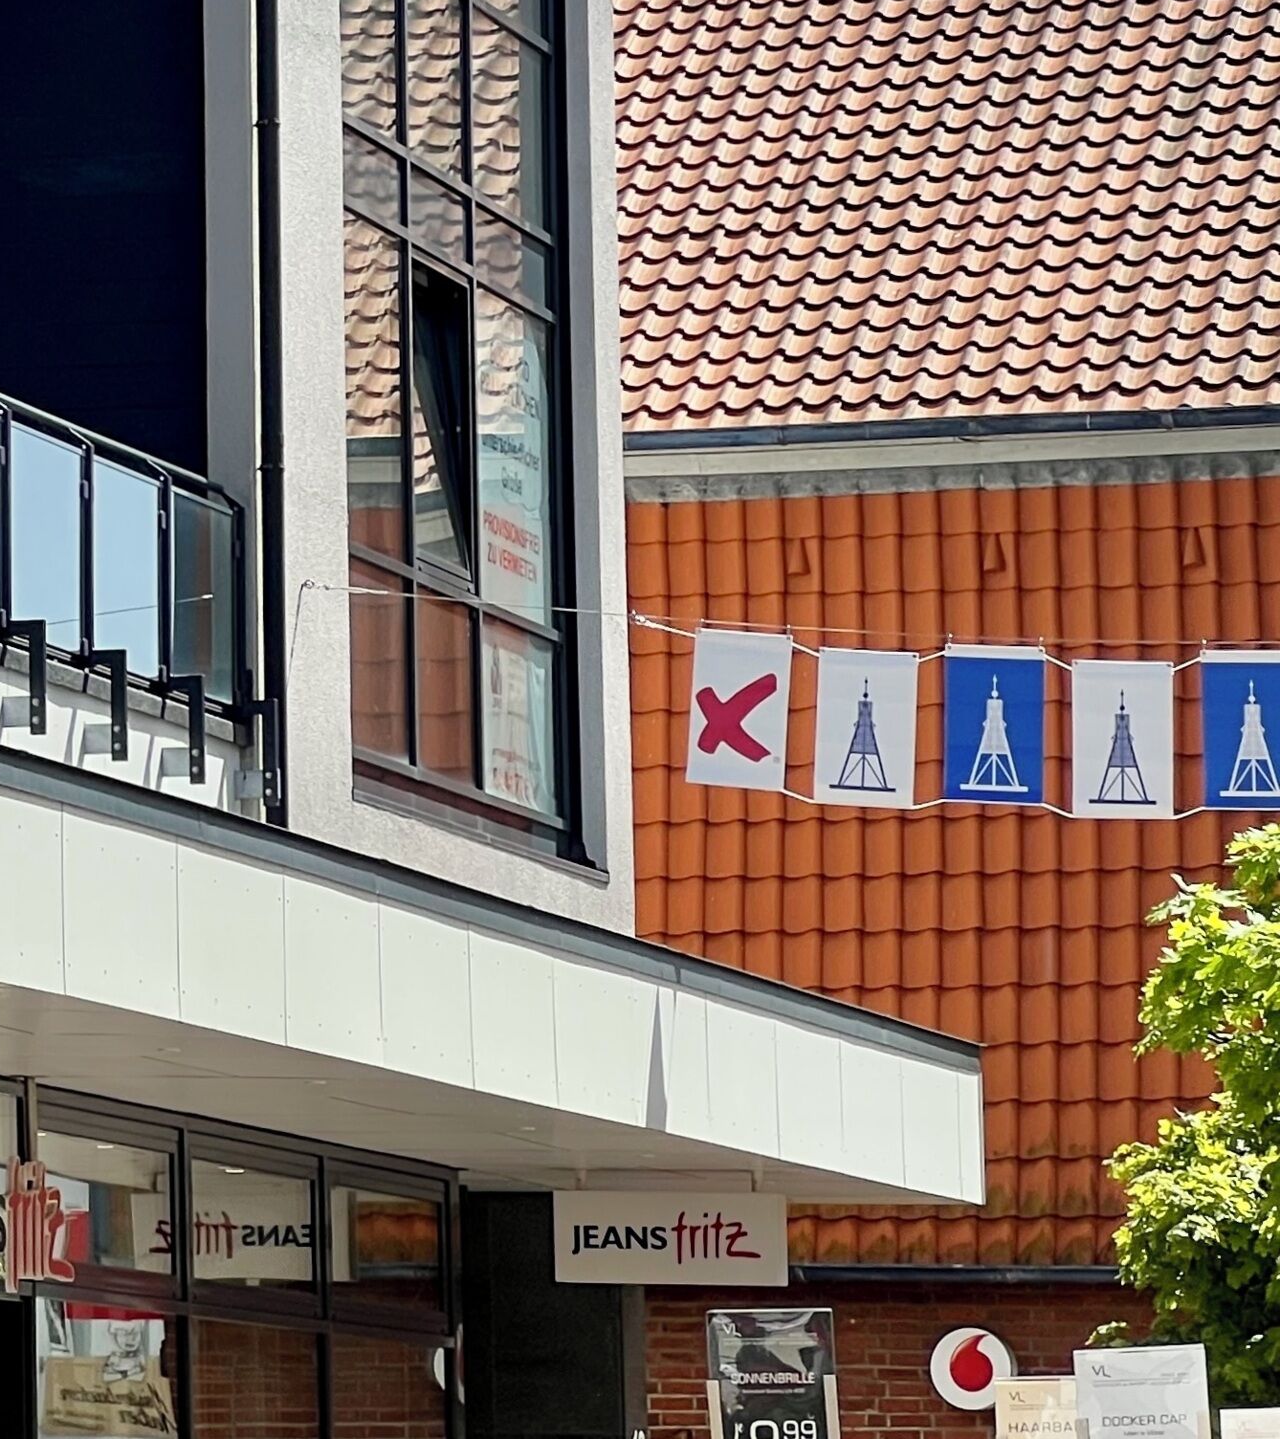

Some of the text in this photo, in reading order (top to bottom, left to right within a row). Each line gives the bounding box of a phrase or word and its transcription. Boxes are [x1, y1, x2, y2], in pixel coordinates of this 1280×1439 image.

[571, 1210, 762, 1265] JEANS fritz
[730, 1371, 816, 1385] SONNENBRILLE
[1007, 1420, 1074, 1434] HAARBA
[1102, 1413, 1188, 1428] DOCKER CAP
